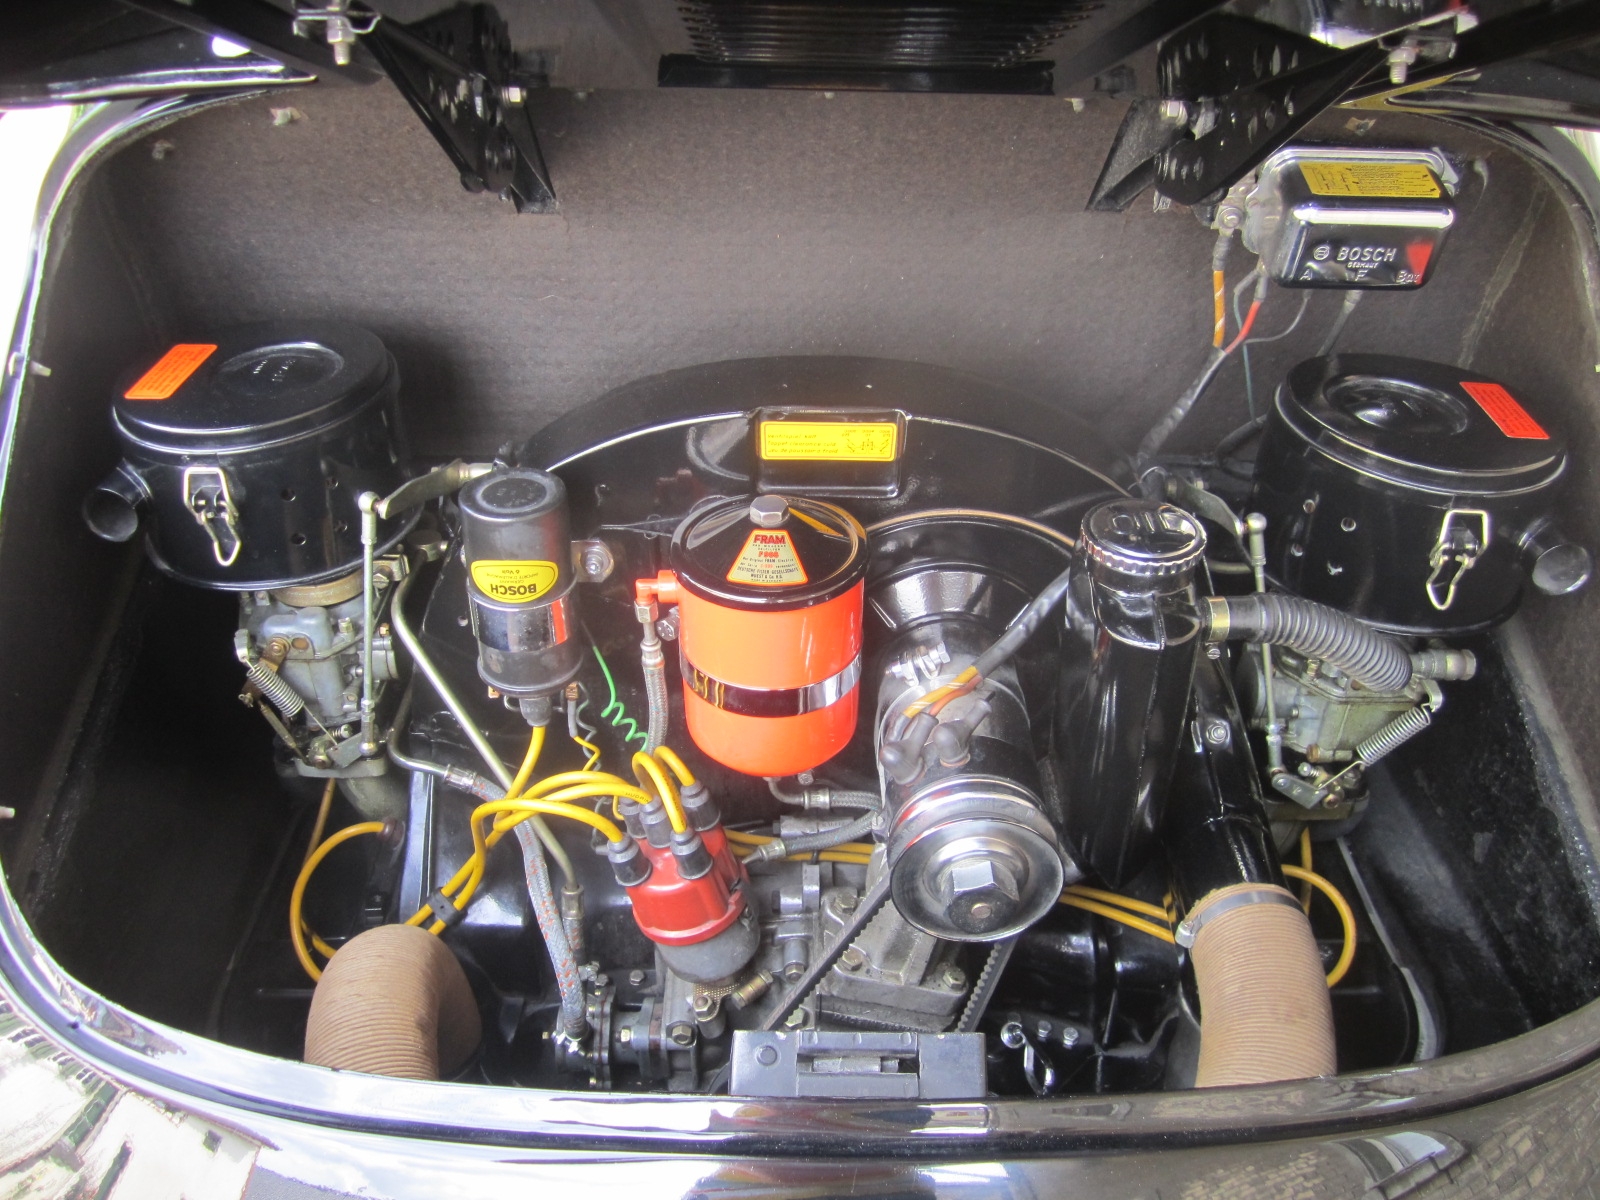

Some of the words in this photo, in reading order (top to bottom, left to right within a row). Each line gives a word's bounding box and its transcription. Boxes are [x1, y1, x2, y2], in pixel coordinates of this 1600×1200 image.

[1337, 246, 1397, 262] BOSCH
[1347, 261, 1379, 269] GERMANY
[1112, 511, 1183, 536] OIL
[752, 534, 787, 544] FRAM
[490, 583, 537, 596] BOSCH
